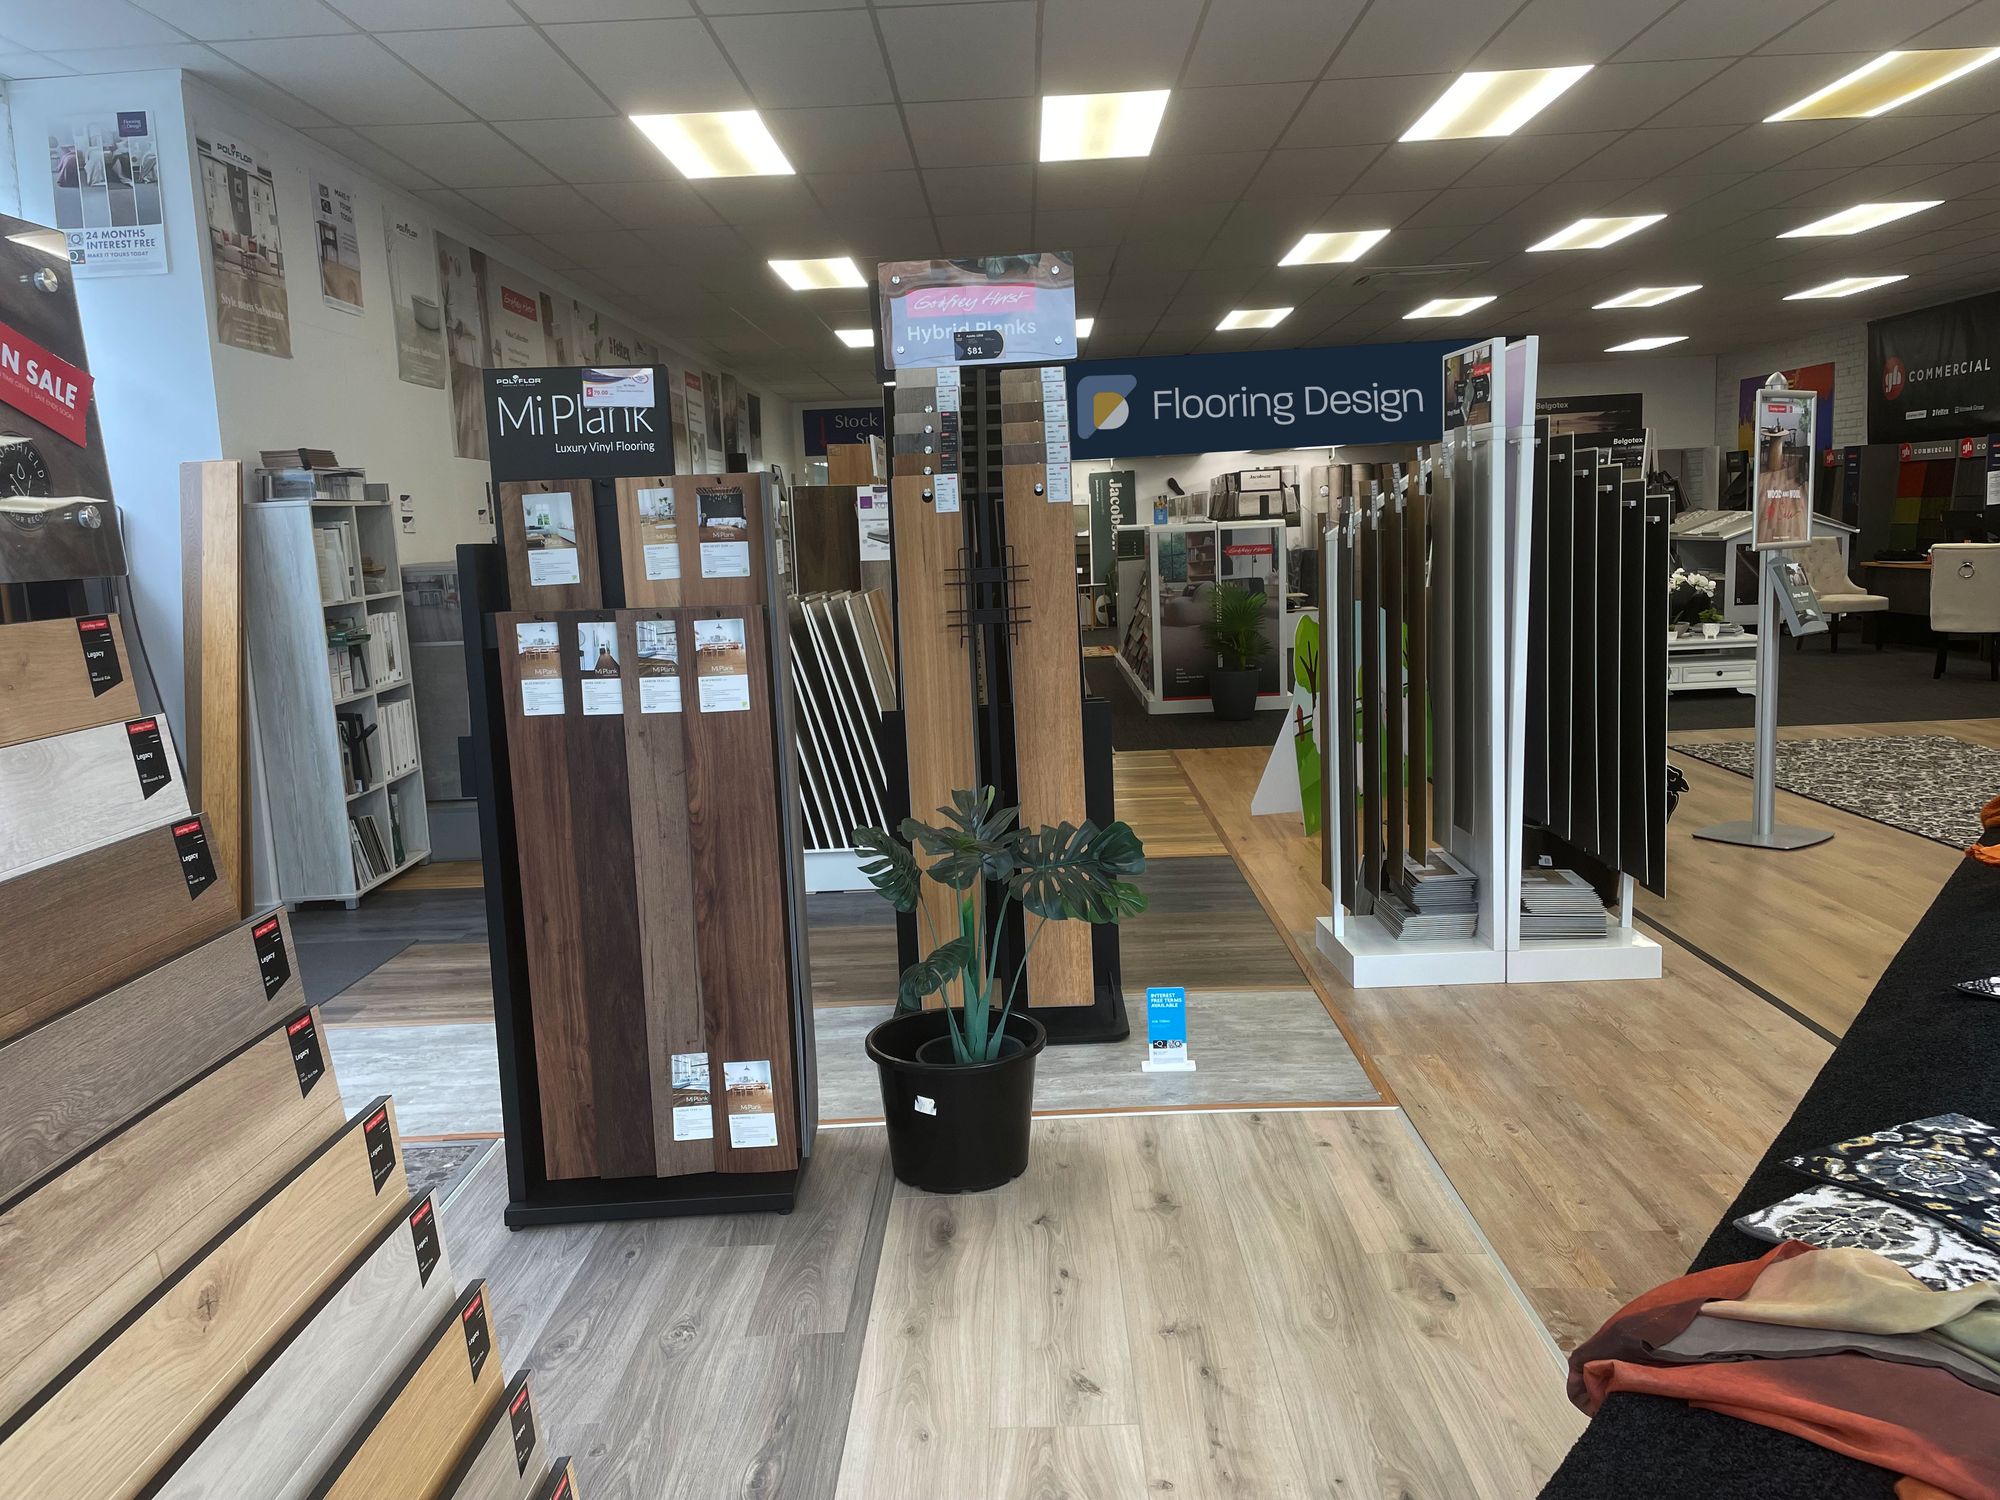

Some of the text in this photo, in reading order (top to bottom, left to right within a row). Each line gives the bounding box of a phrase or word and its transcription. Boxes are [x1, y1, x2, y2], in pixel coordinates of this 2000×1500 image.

[217, 142, 253, 163] POLYFLOR
[86, 228, 145, 240] 24 MONTHS
[86, 238, 155, 250] INTEREST FREE
[914, 290, 1030, 312] Godfrey Hirst
[1908, 357, 1992, 384] COMMERCIAL
[26, 360, 78, 410] SALE
[496, 377, 542, 385] POLYFLOR
[1153, 382, 1424, 425] Flooring Design
[834, 412, 879, 429] Stock
[555, 440, 655, 454] Luxury Vinyl Flooring
[1613, 436, 1643, 446] Belgotex
[1914, 446, 1952, 455] COMMERCIAL
[86, 650, 105, 659] Legacy
[136, 752, 153, 761] Legacy
[182, 852, 199, 863] Legacy
[260, 951, 276, 964] Legacy
[295, 1048, 310, 1061] Legacy
[370, 1143, 384, 1158] Legacy
[417, 1235, 430, 1251] Legacy
